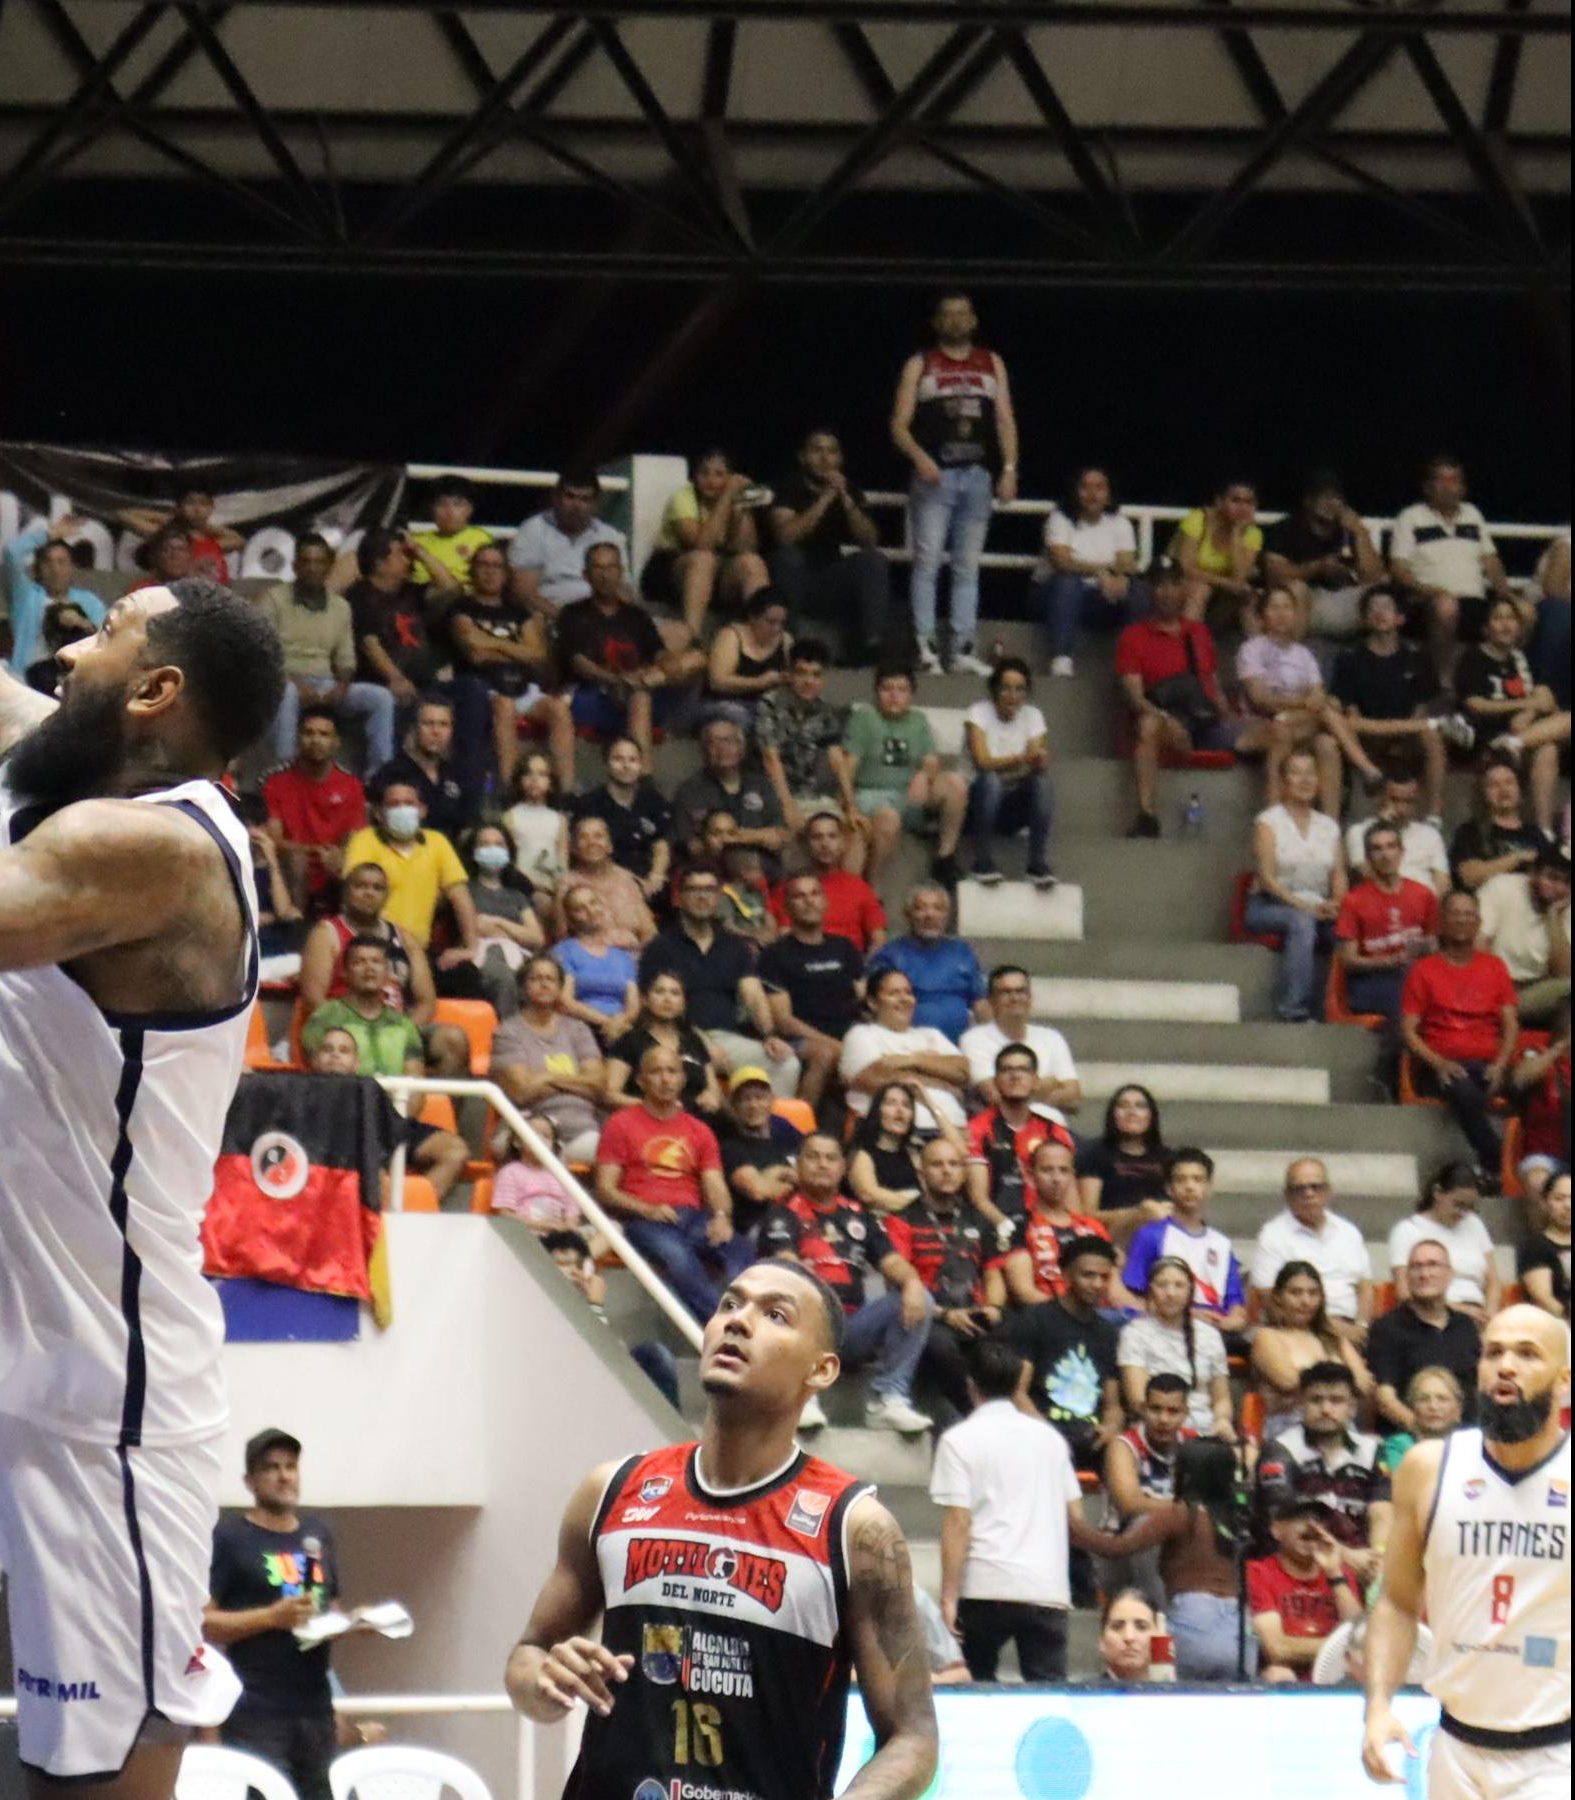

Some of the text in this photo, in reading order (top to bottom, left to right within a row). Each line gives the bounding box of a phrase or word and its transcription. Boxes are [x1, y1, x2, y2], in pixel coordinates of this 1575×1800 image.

[1456, 1519, 1567, 1562] TITANES
[661, 1581, 736, 1607] DEL NORTE
[1490, 1573, 1515, 1625] 8
